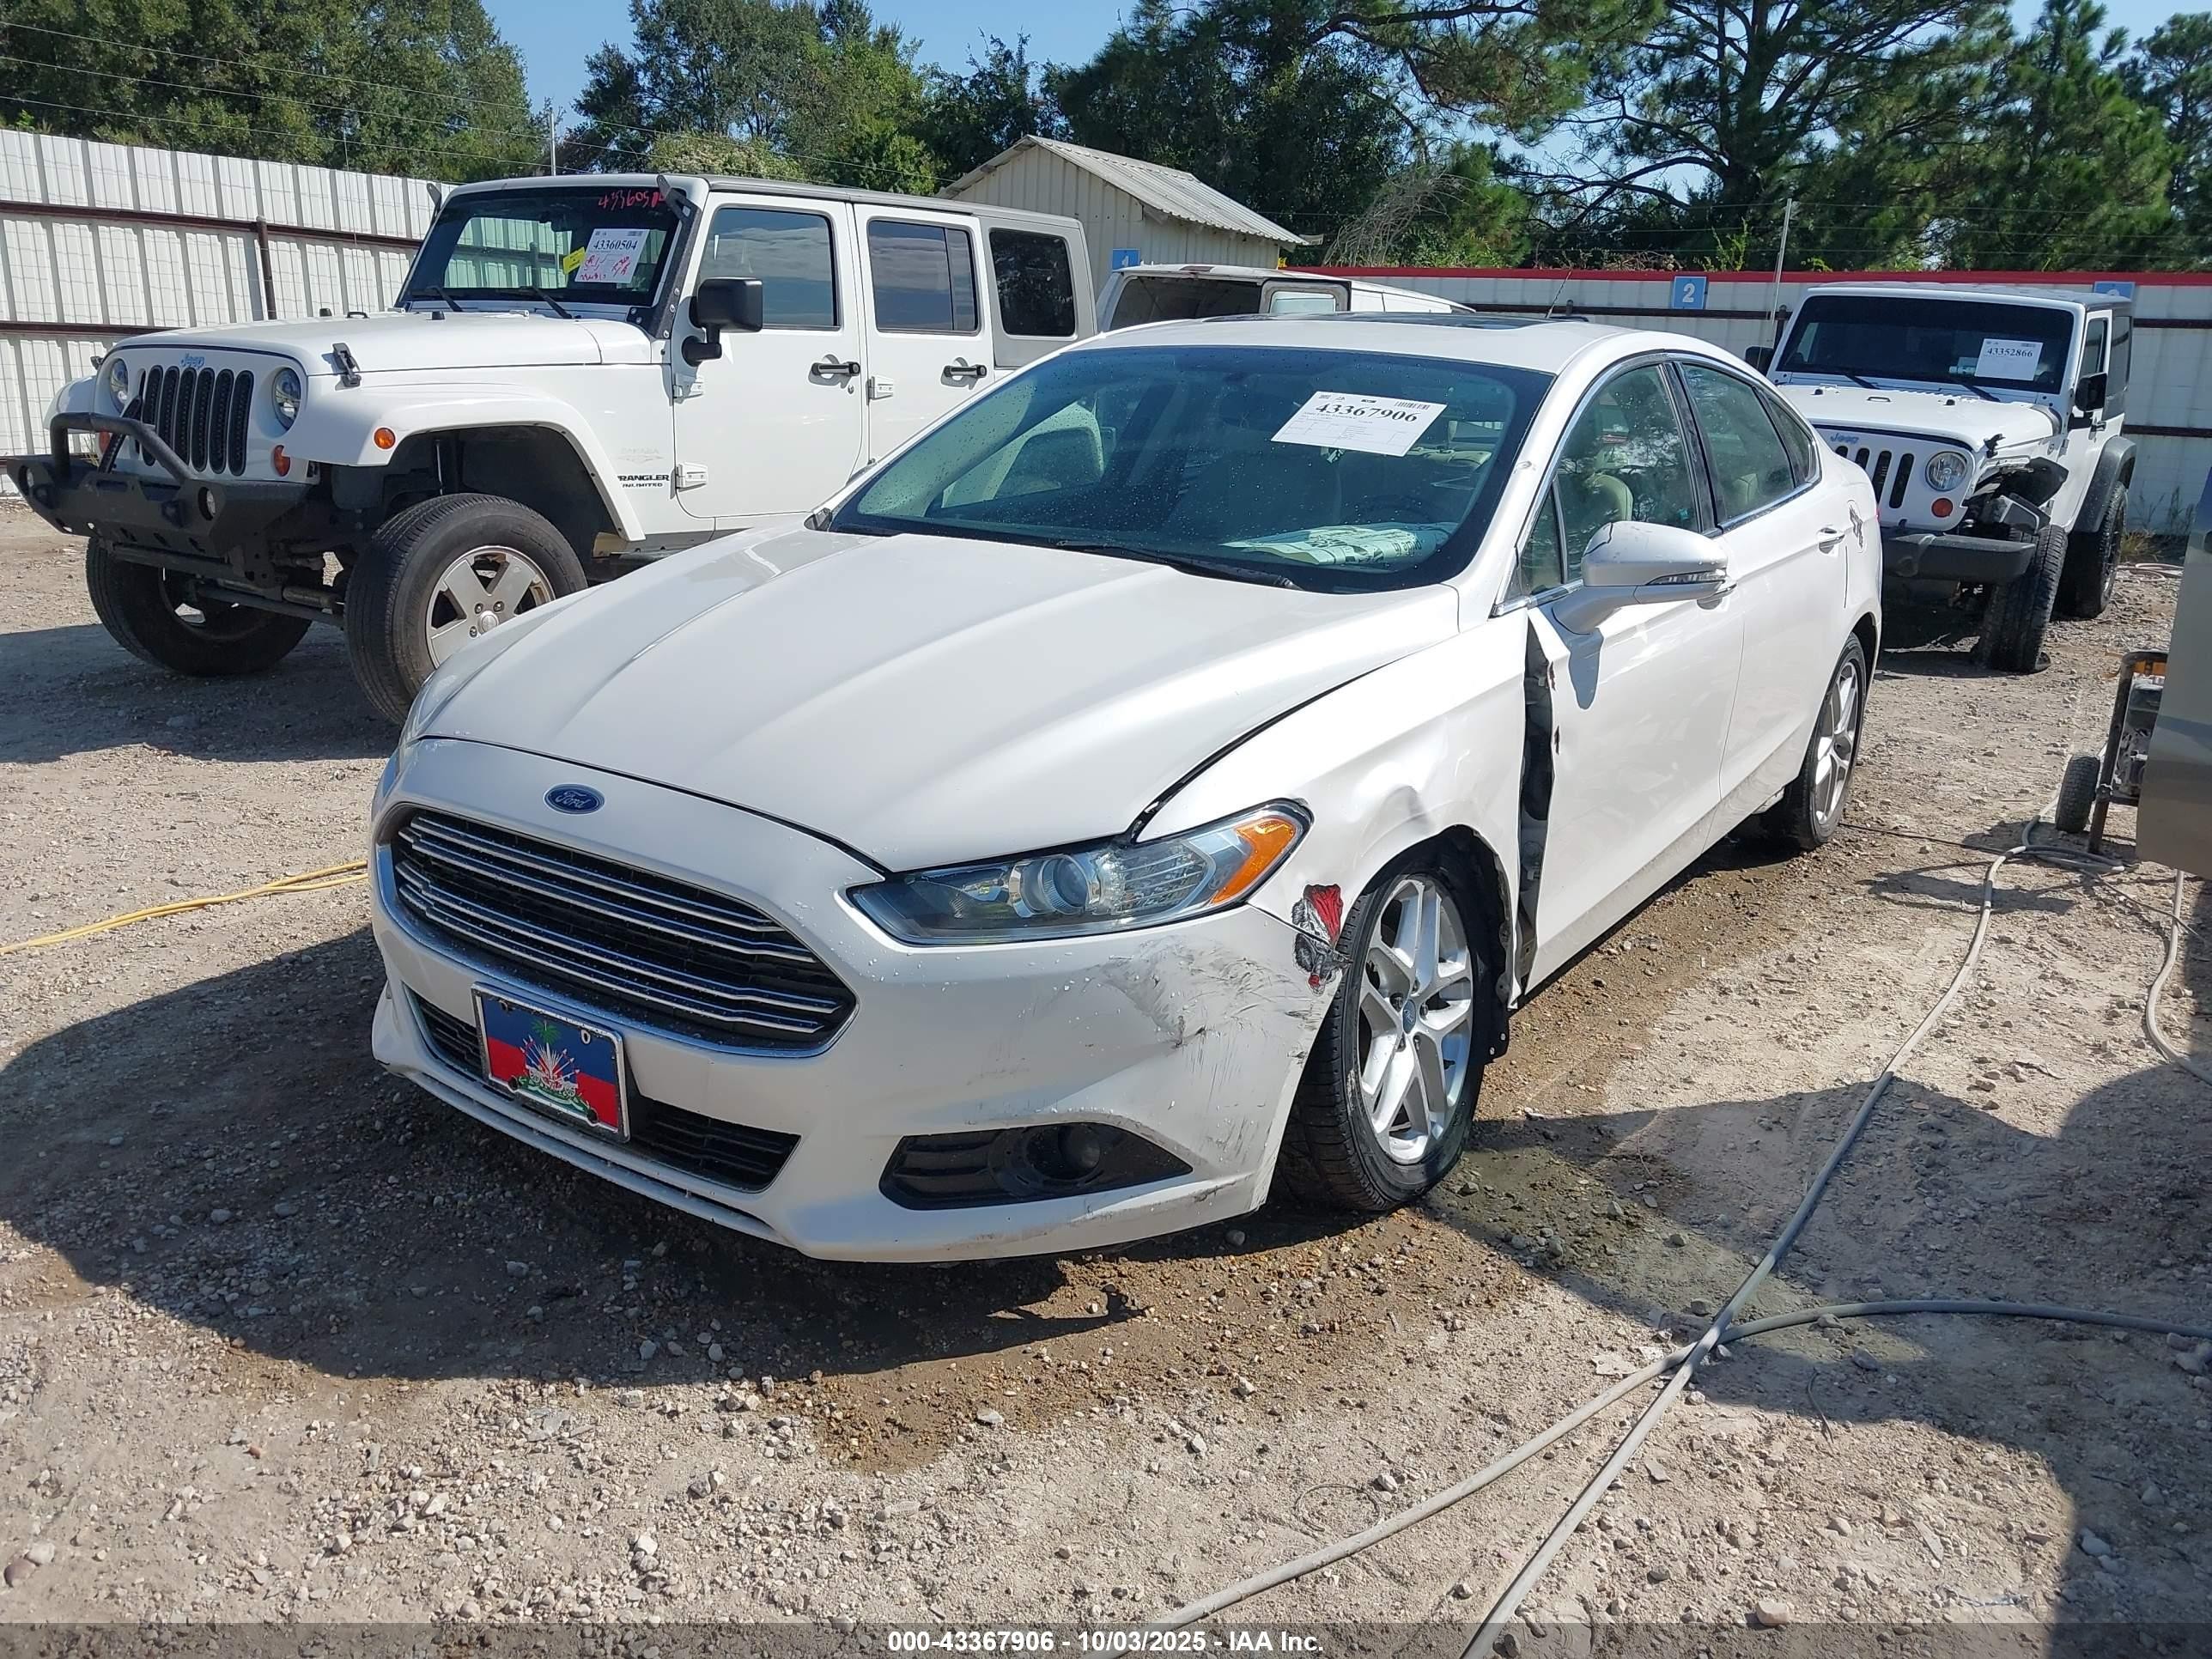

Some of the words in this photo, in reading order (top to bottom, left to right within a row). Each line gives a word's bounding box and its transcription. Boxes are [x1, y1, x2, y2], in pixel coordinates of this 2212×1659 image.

[592, 240, 639, 250] 43360504
[1682, 283, 1696, 303] 2
[1987, 347, 2033, 357] 43352866
[1315, 402, 1421, 422] 43367906
[554, 790, 592, 809] Ford
